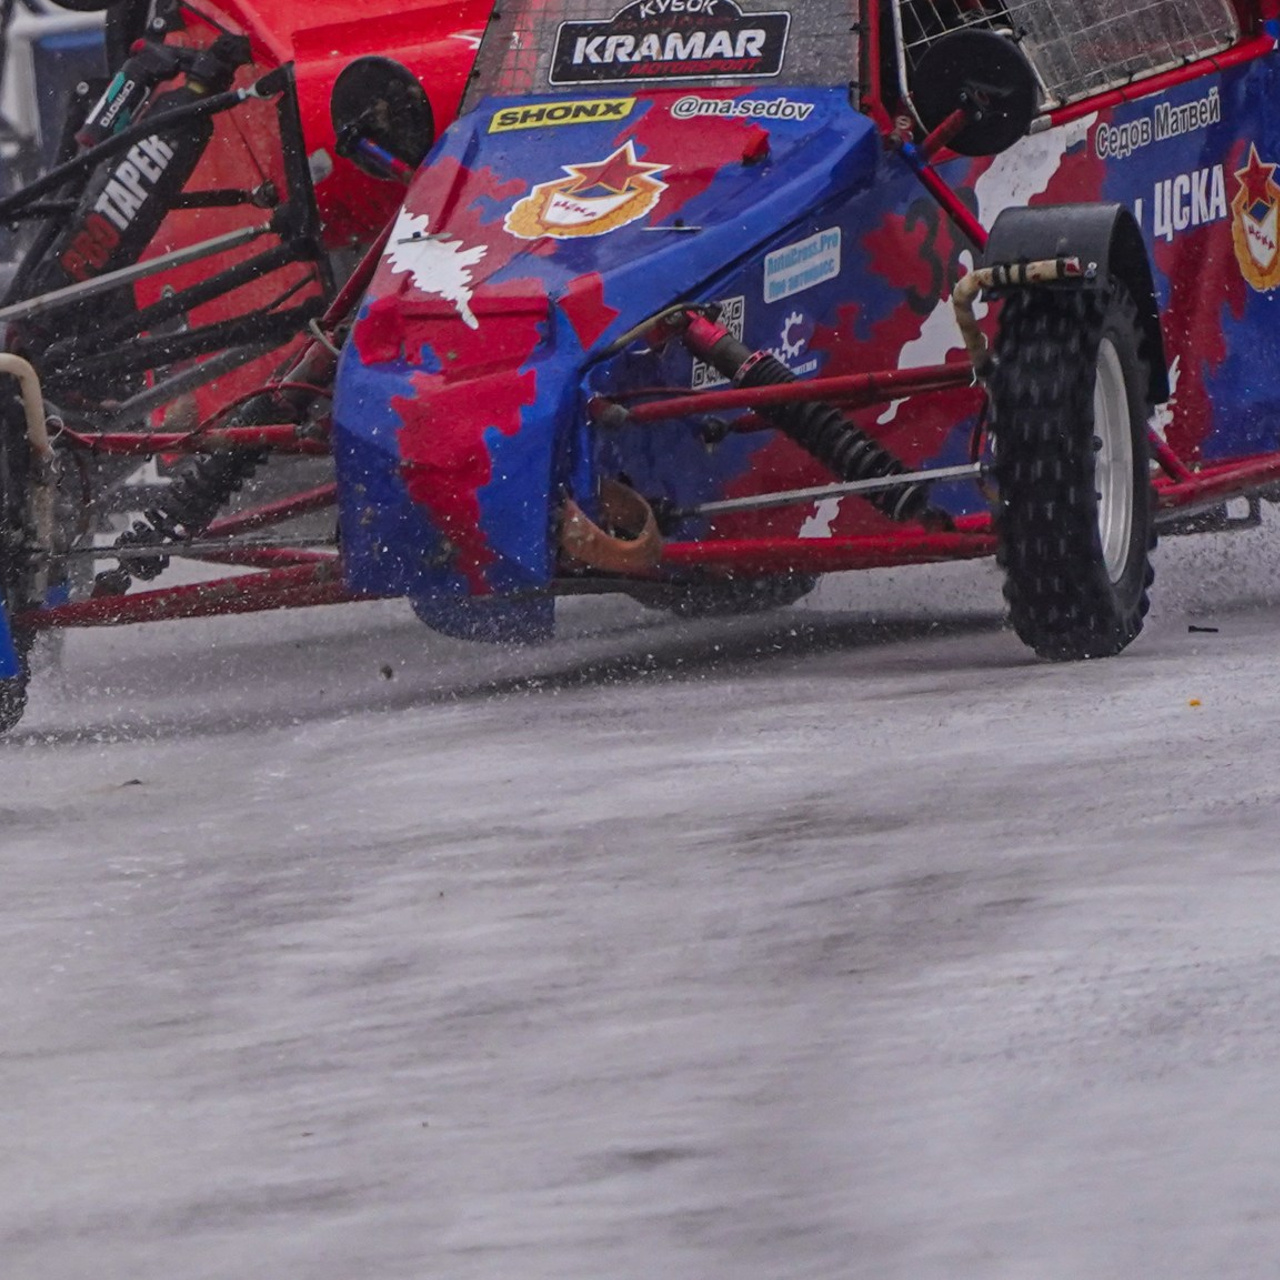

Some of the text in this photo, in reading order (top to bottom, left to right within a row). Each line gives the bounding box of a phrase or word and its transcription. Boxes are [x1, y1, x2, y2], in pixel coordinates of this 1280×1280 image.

[572, 28, 767, 65] KRAMAR
[497, 102, 626, 127] SHONX
[671, 95, 815, 121] @ma.sedov
[1095, 86, 1221, 160] Седов Матвей
[1153, 163, 1227, 242] ЦСКА
